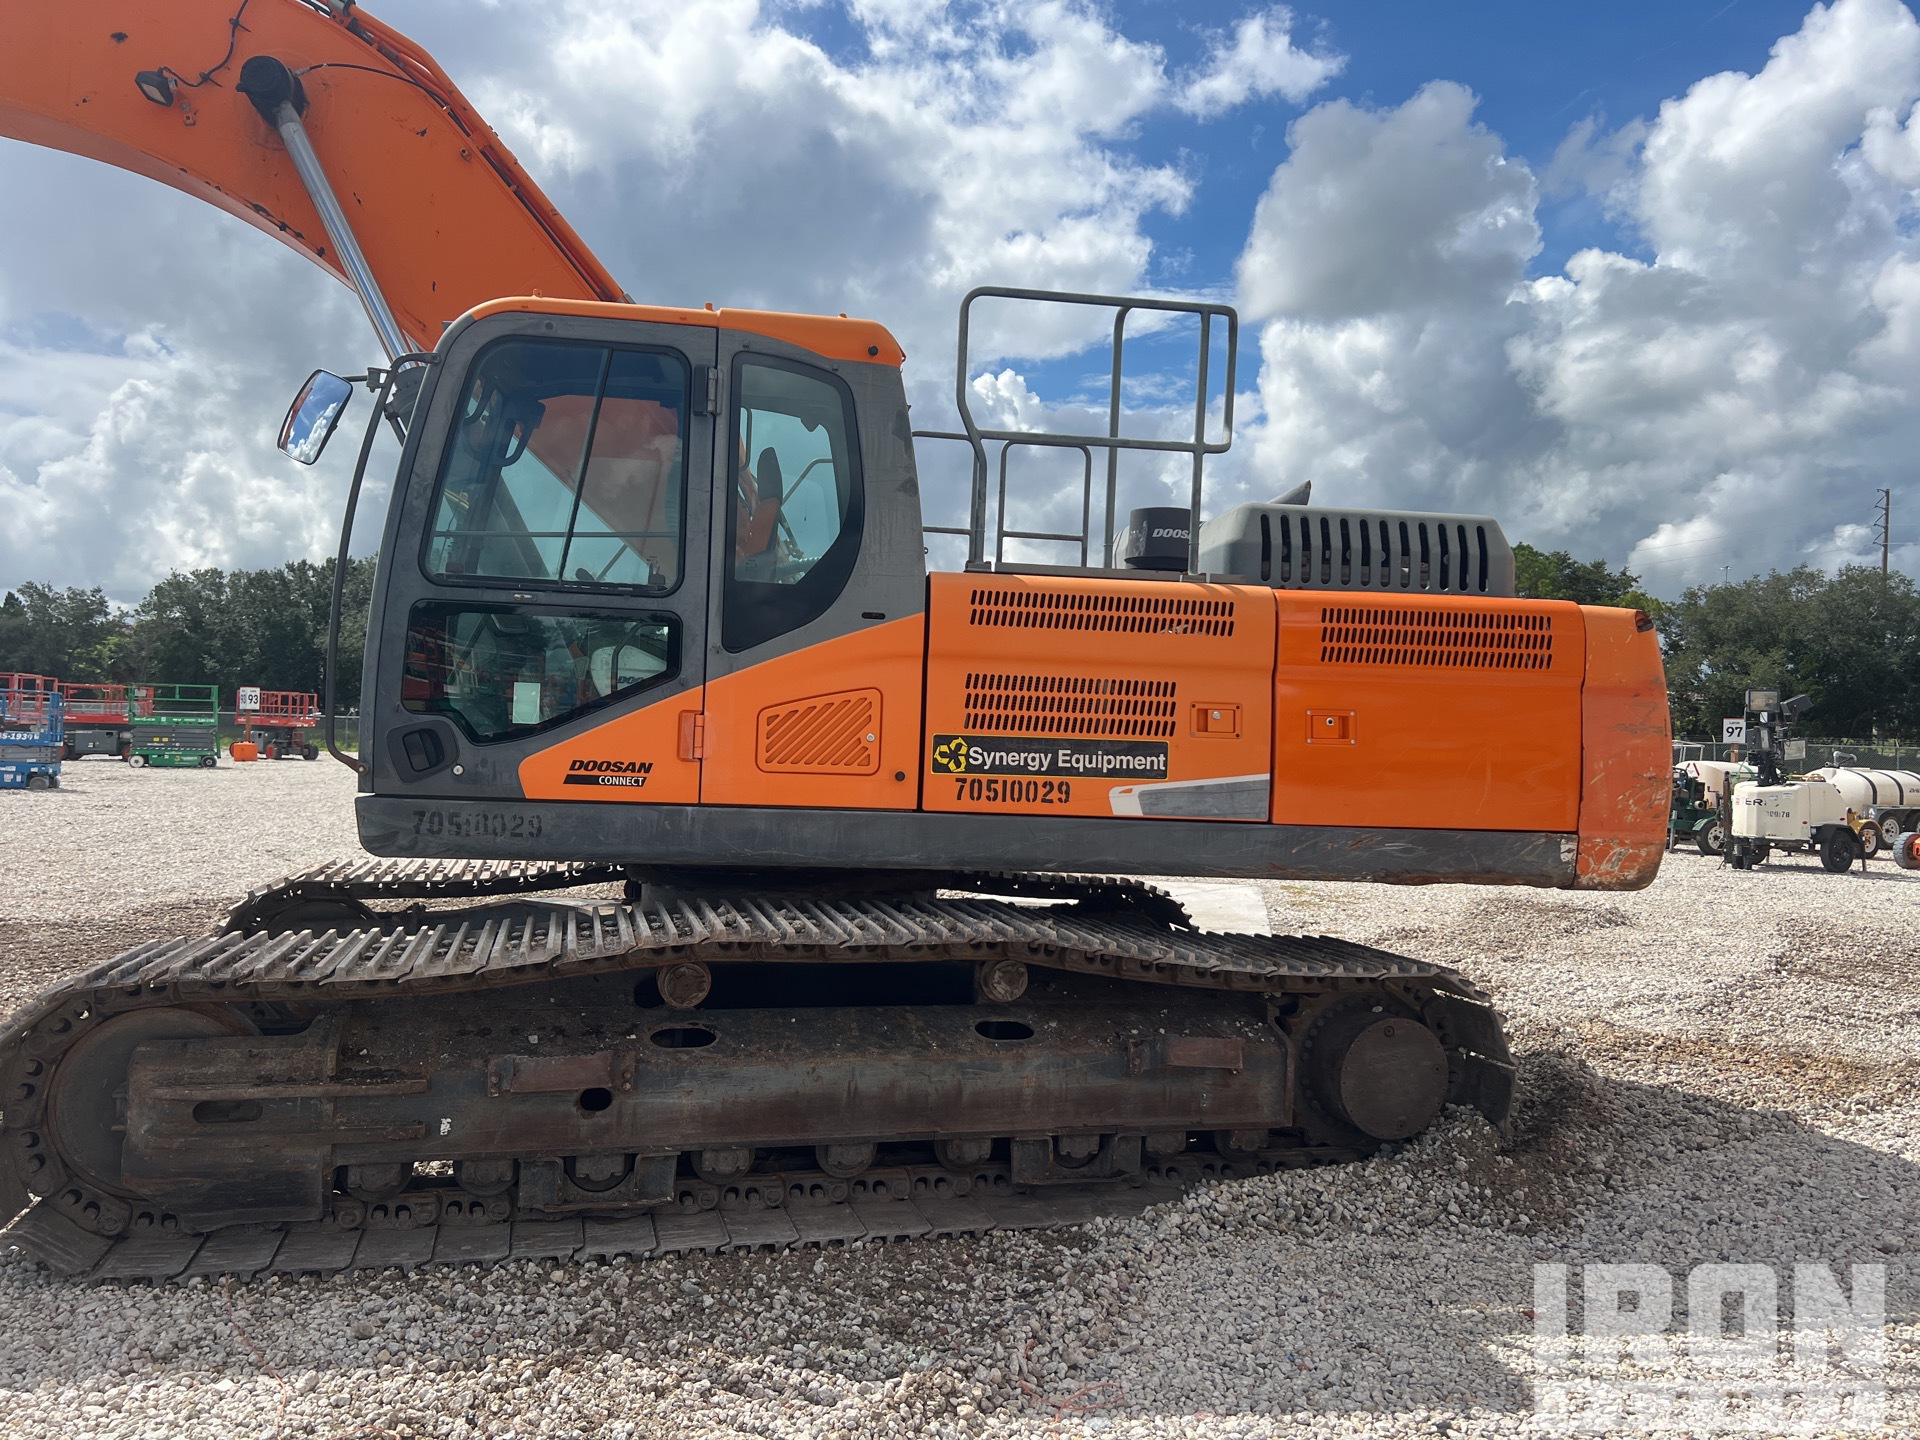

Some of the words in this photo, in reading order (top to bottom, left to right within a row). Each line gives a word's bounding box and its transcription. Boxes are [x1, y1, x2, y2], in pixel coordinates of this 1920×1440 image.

[1152, 528, 1191, 539] DOOS
[248, 694, 258, 704] 93
[0, 732, 33, 740] S-1939
[1726, 726, 1743, 737] 97
[969, 746, 1052, 771] Synergy
[1058, 749, 1166, 772] Equipment
[569, 760, 653, 774] DOOSAN
[598, 776, 644, 786] CONNECT
